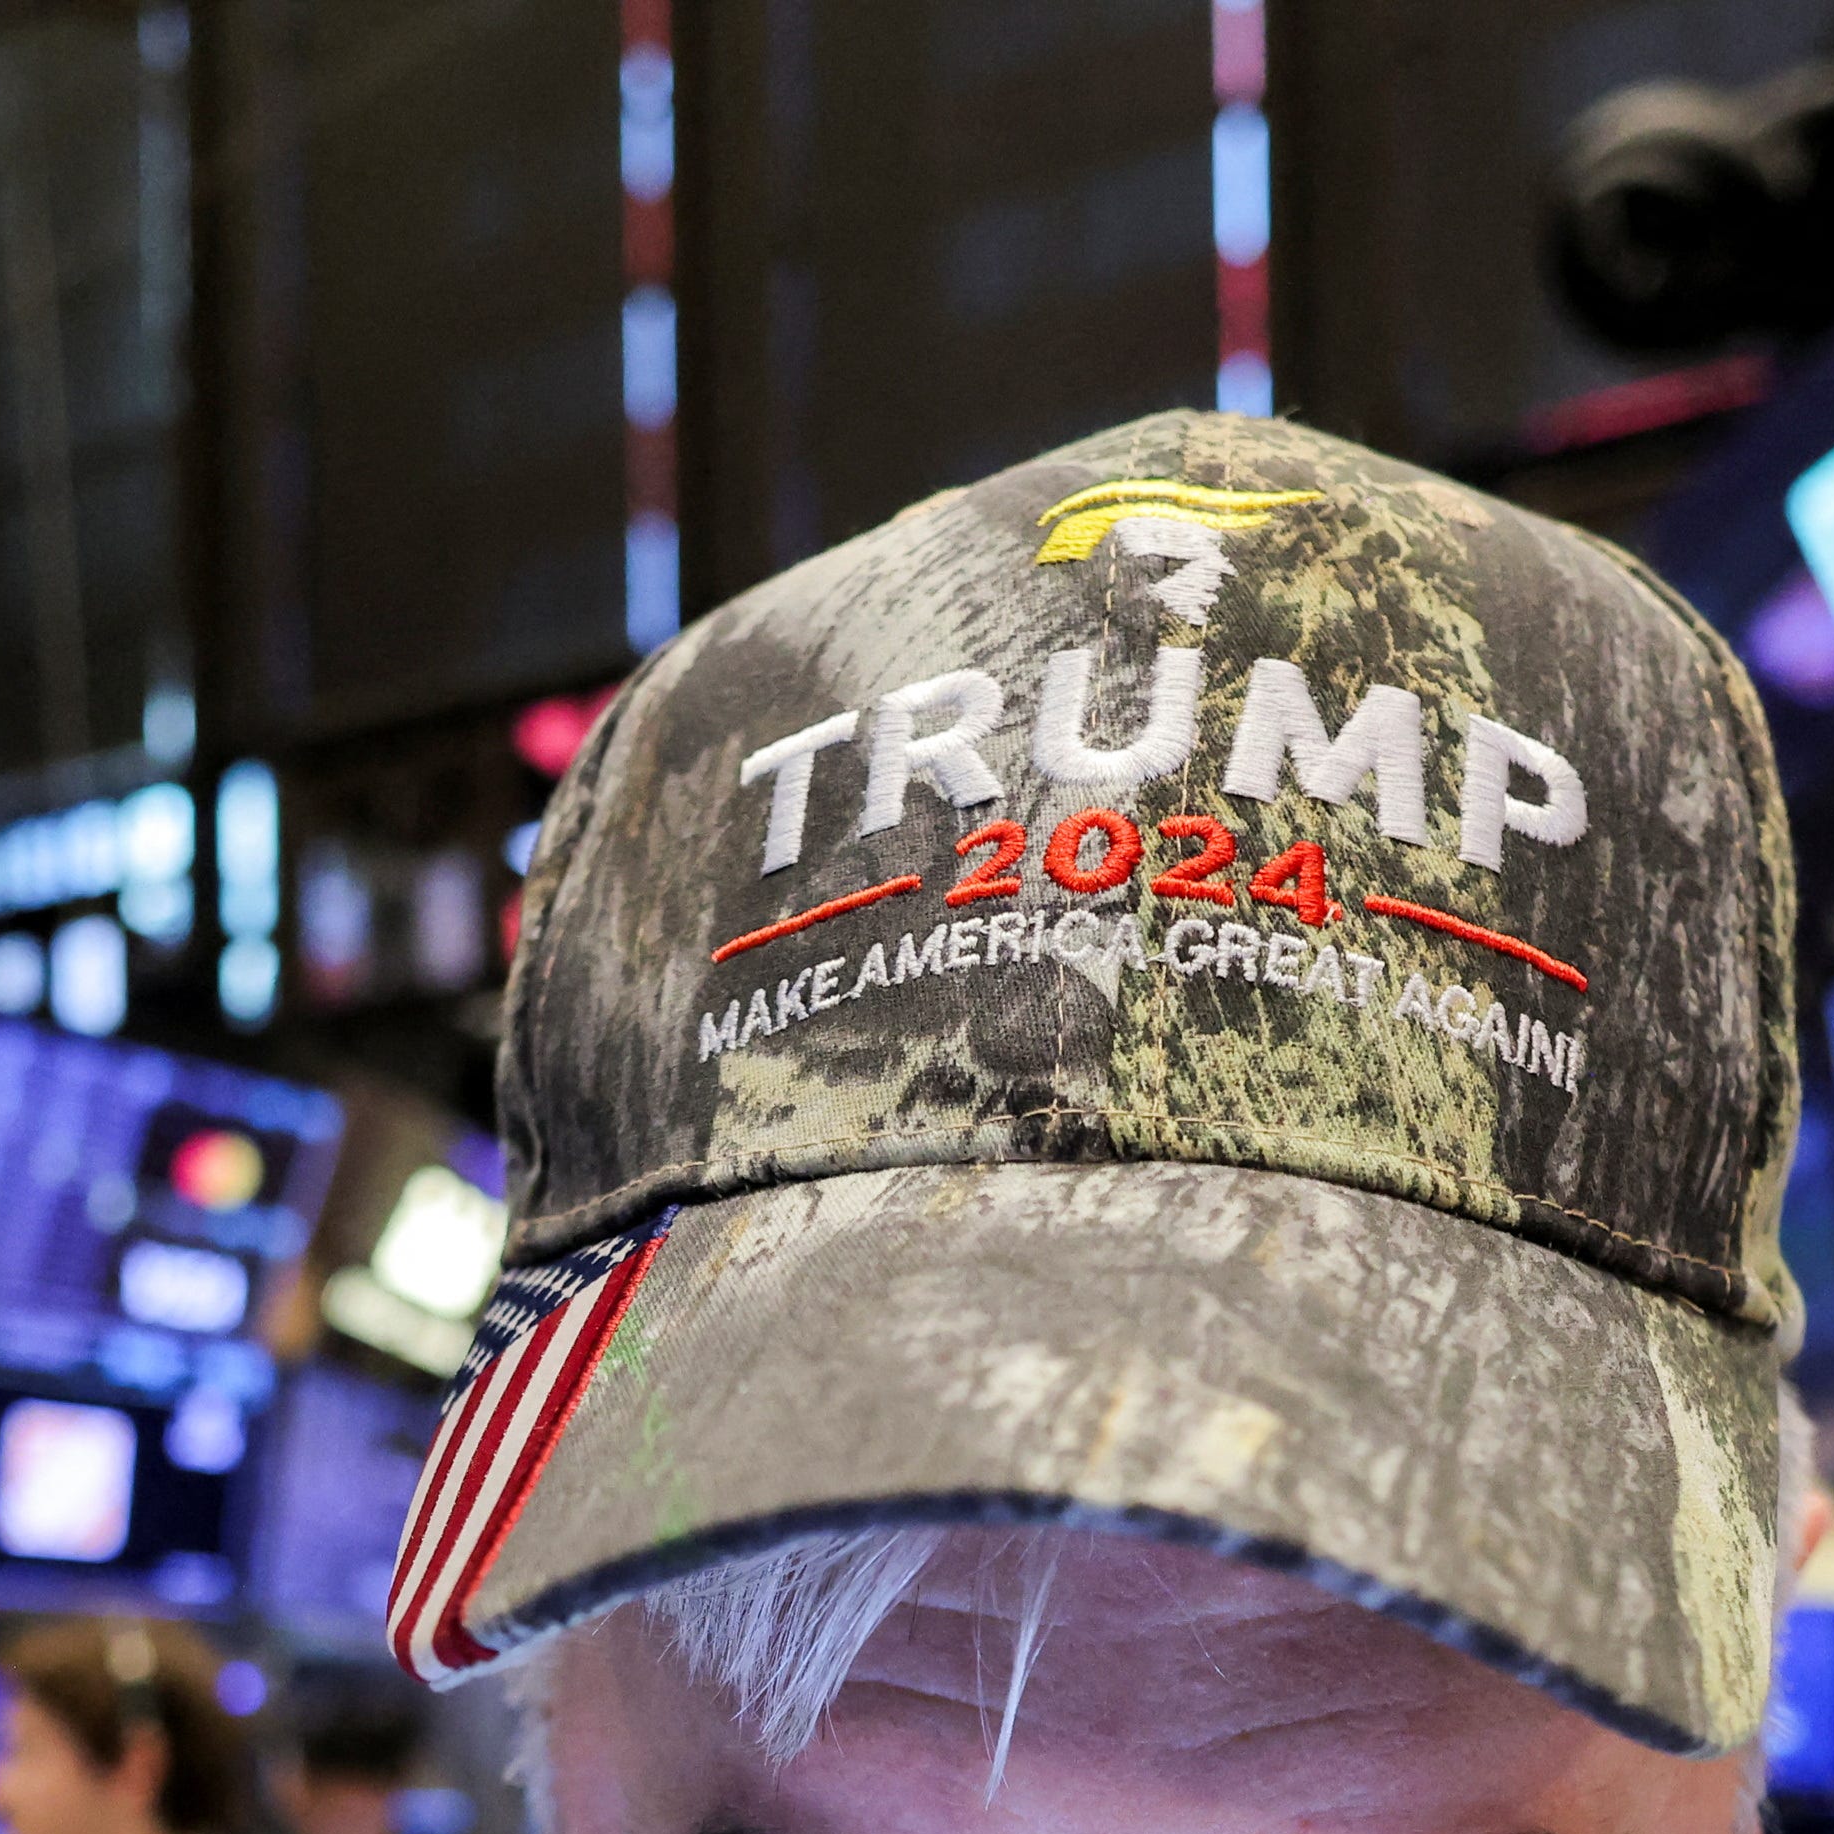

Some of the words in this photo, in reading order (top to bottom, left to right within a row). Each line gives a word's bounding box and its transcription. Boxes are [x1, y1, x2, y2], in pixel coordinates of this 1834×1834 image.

[741, 647, 1587, 875] TRUMP
[945, 807, 1344, 928] 2024
[698, 956, 846, 1063] MAKE
[851, 908, 1147, 998] AMERICA
[1167, 918, 1385, 1008] GREAT
[1394, 972, 1584, 1098] AGAIN!
